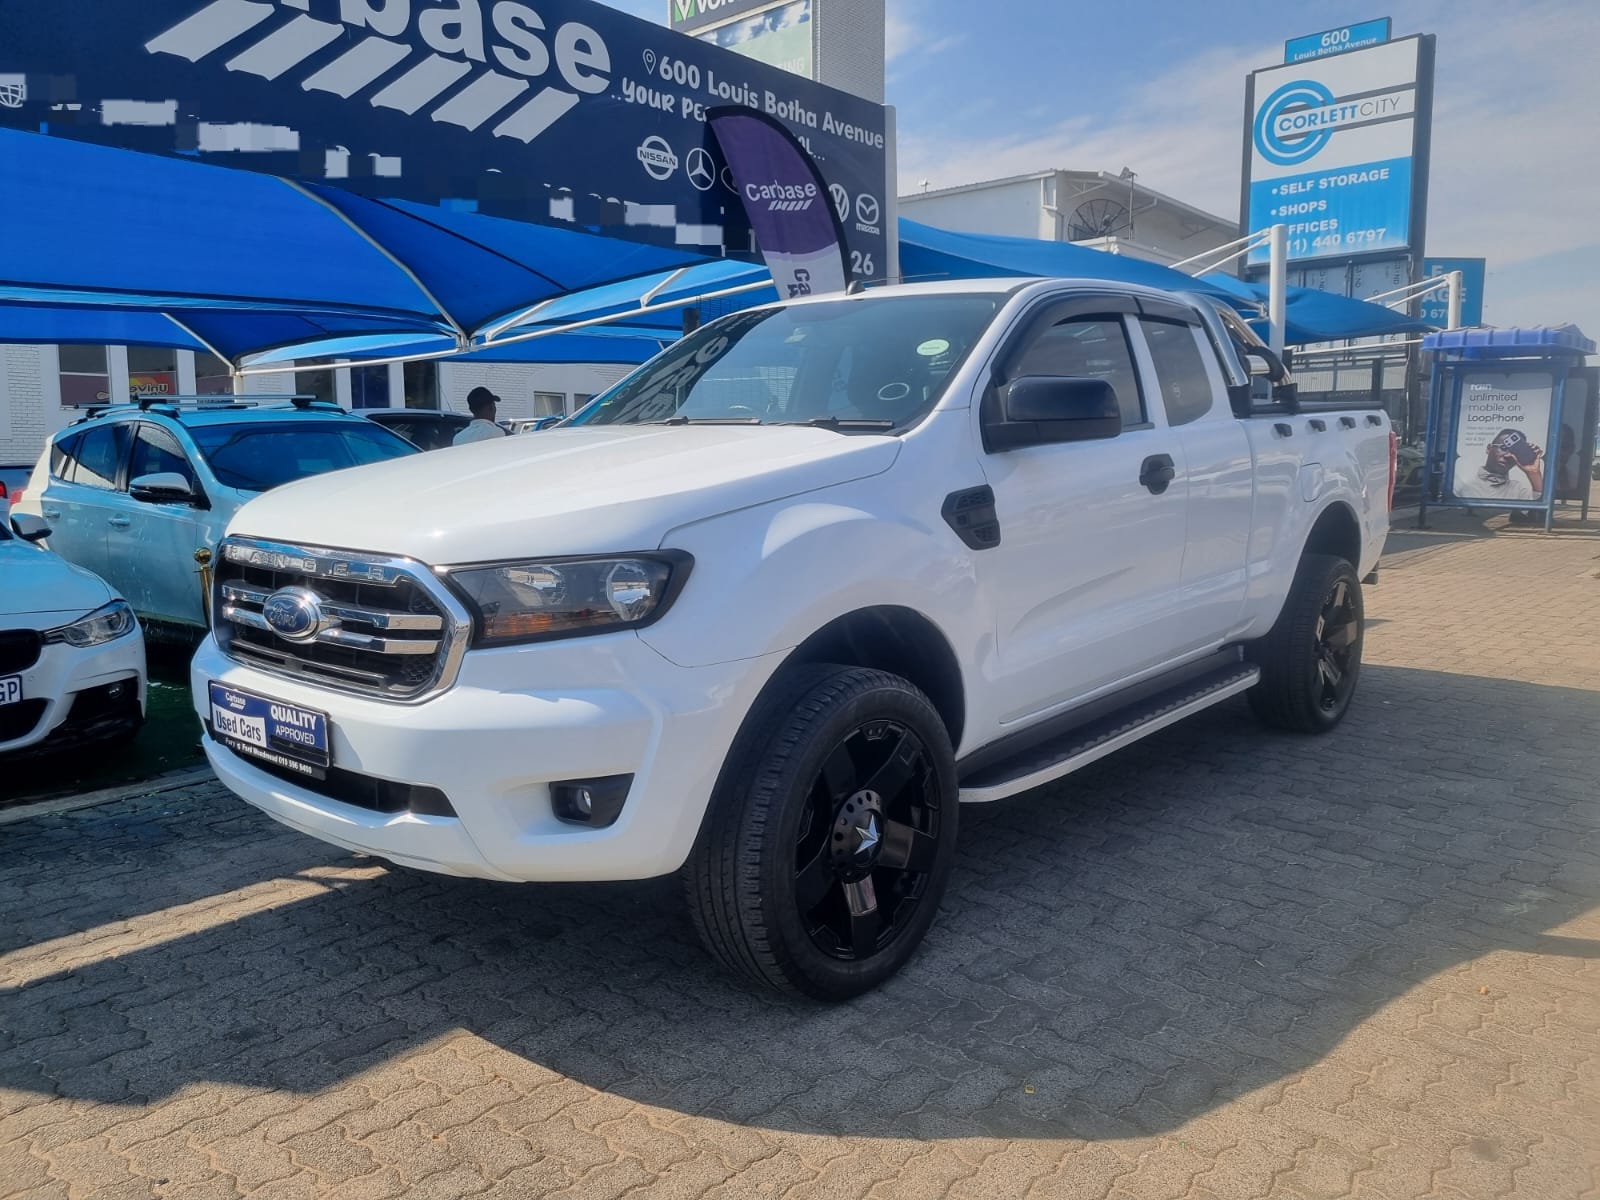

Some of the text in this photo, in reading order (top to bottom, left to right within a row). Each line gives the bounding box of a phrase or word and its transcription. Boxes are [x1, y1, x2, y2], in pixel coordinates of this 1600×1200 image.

[1321, 29, 1350, 47] 600
[1294, 37, 1377, 61] Louis Botha Avenue
[659, 56, 884, 148] 600 Louis Botha Avenue
[640, 150, 676, 166] NISSAN
[746, 179, 817, 201] Carbase
[1280, 168, 1390, 196] SELF STORAGE
[1278, 200, 1327, 217] SHOPS
[1287, 218, 1339, 236] FFICES
[1312, 234, 1341, 248] 440
[1346, 228, 1387, 244] 6797
[1469, 392, 1518, 402] unlimited
[1469, 403, 1521, 412] mobile on
[1467, 413, 1525, 423] LoopPhone
[225, 544, 385, 581] RANGER
[268, 602, 299, 629] Ford
[216, 710, 262, 742] Used Cars
[270, 704, 317, 730] QUALITY
[275, 725, 316, 745] APPROVED
